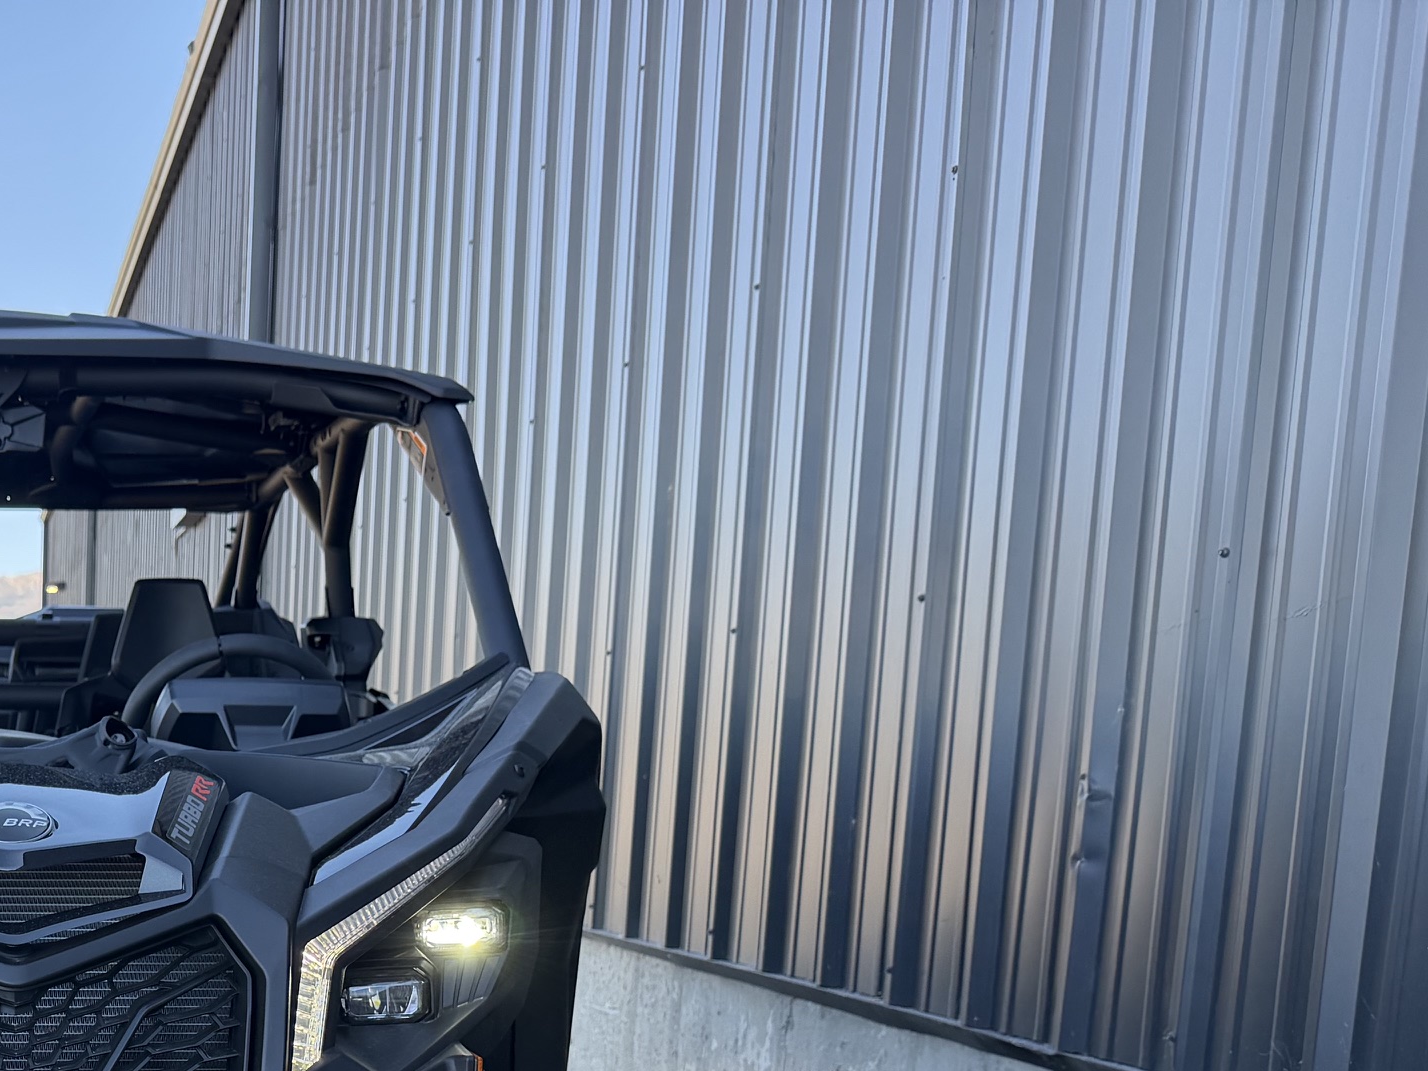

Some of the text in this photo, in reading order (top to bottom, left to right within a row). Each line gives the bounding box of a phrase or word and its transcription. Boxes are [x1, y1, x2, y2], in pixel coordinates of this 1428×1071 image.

[3, 818, 47, 828] BRP
[171, 775, 214, 844] TURBO RR
